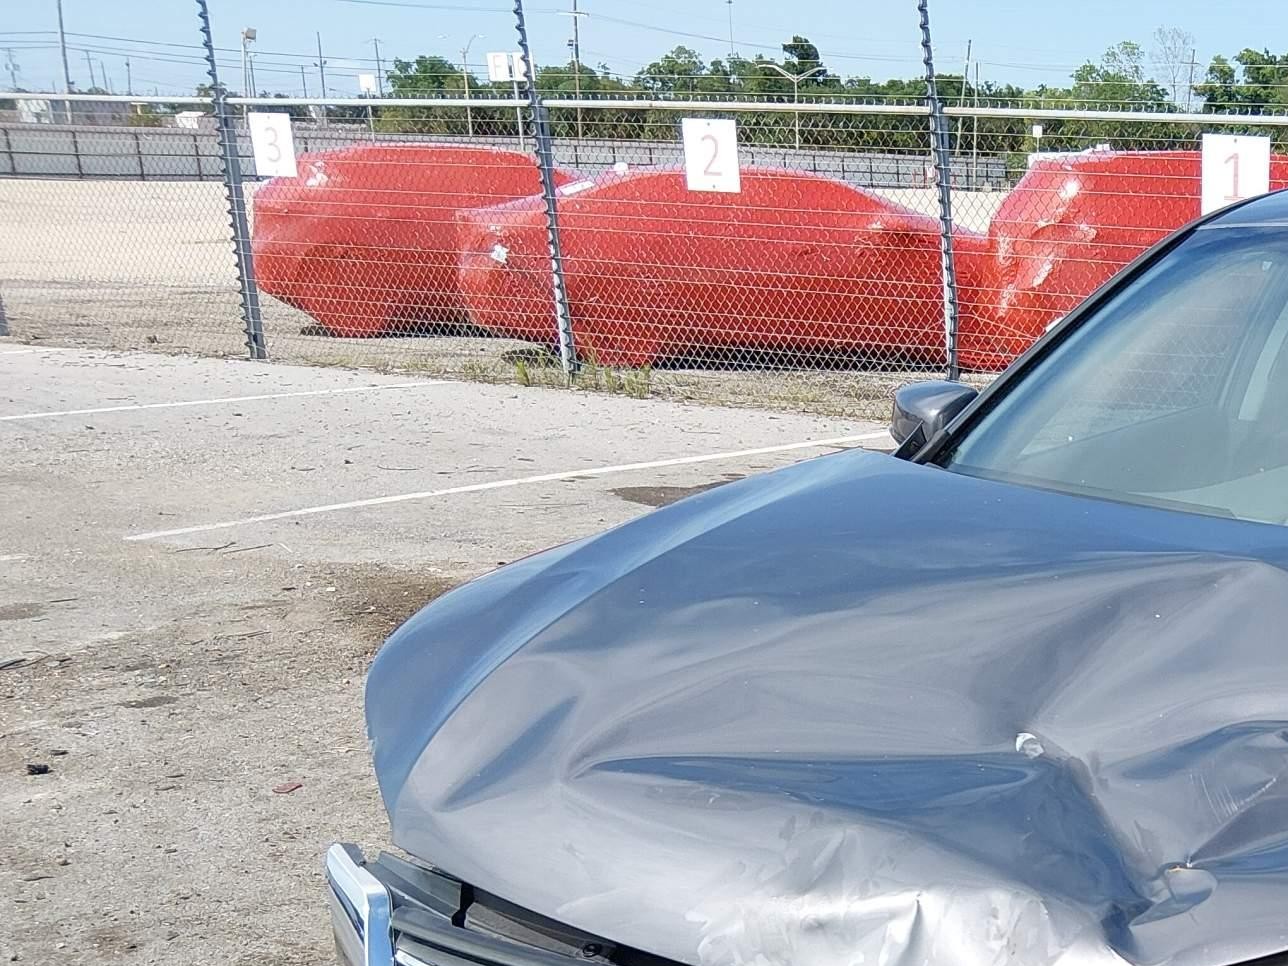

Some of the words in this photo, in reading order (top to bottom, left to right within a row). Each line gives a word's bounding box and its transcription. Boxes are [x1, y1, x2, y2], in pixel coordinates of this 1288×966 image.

[264, 126, 281, 162] 3
[701, 134, 723, 176] 2
[1224, 153, 1245, 200] 1
